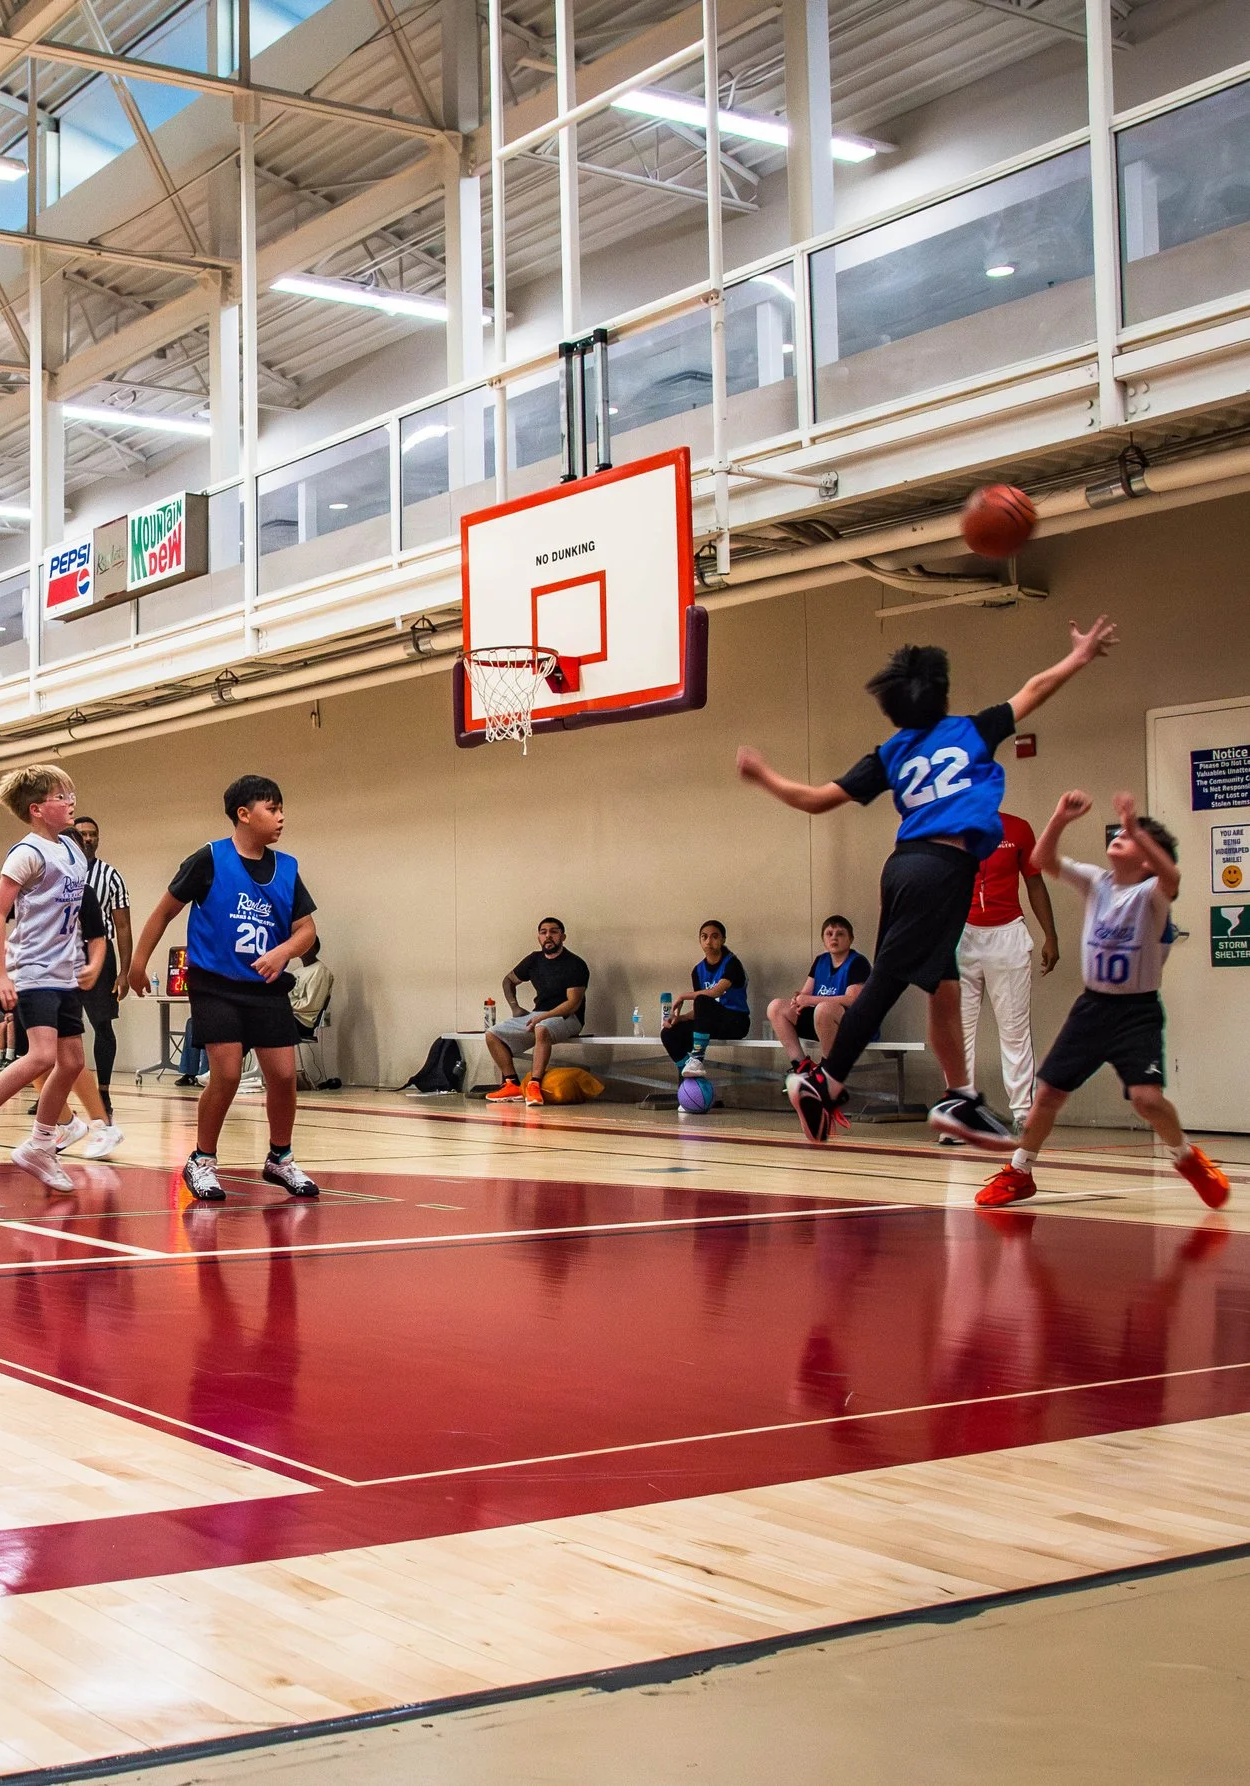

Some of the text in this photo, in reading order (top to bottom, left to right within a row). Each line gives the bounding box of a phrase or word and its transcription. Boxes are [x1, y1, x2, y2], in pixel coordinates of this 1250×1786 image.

[535, 540, 595, 566] NO DUNKING
[49, 542, 91, 578] PEPSI
[1212, 748, 1248, 760] Notice
[898, 746, 972, 809] 22
[1196, 769, 1226, 778] Valuables
[1209, 775, 1244, 785] Community
[1211, 800, 1231, 808] Stolen
[1220, 828, 1244, 837] YOU ARE
[1223, 838, 1241, 846] BEING
[235, 922, 269, 956] 20
[1218, 941, 1248, 950] STORM
[1215, 950, 1250, 959] SHELTER
[1094, 952, 1130, 985] 10
